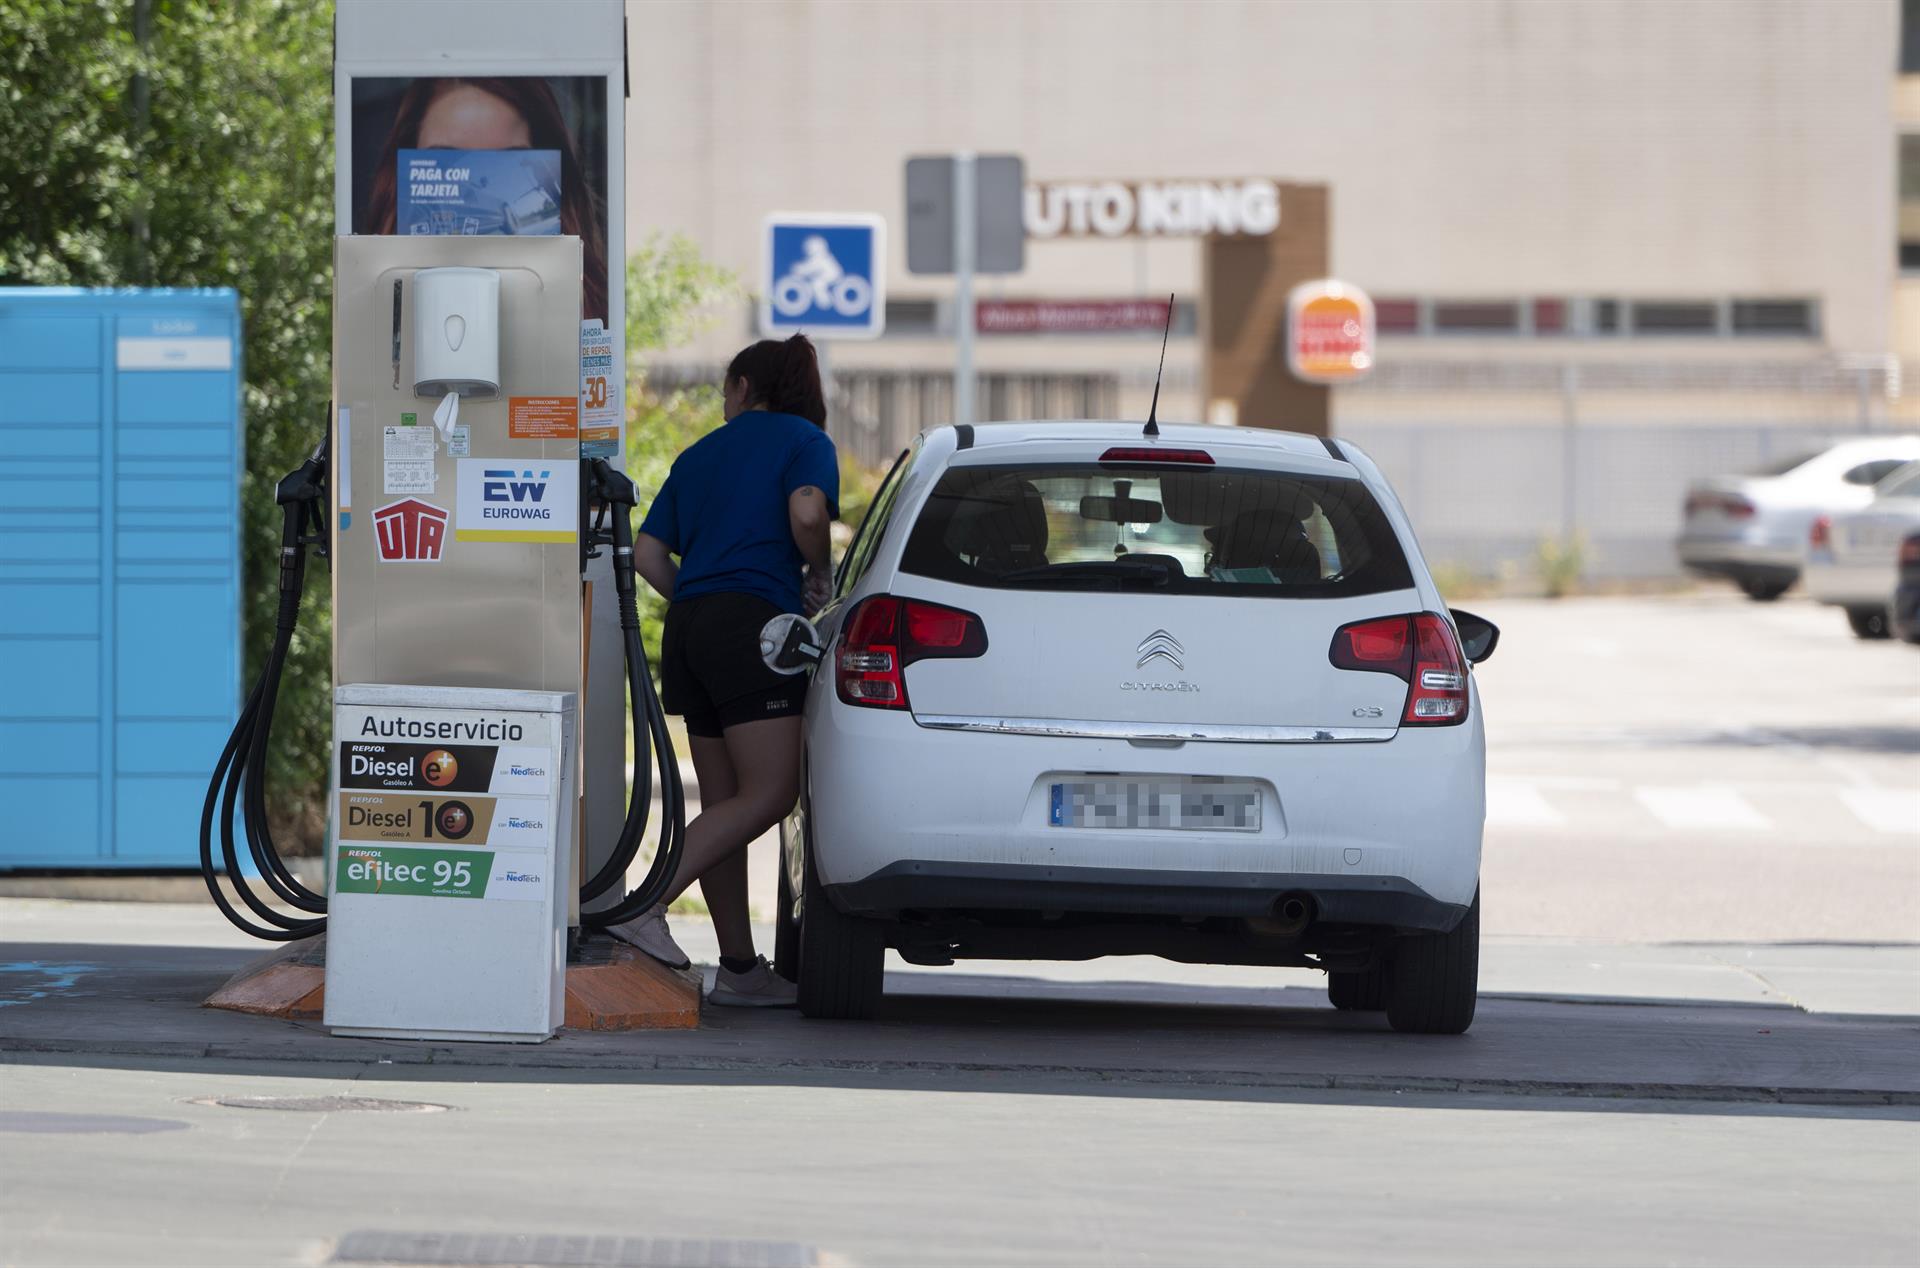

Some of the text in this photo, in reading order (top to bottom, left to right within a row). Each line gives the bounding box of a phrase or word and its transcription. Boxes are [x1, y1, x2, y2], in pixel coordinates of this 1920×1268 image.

[410, 168, 470, 182] PAGA CON
[410, 184, 460, 197] TARJETA
[1024, 179, 1280, 237] UTO KING
[583, 327, 602, 337] AHORA
[583, 345, 612, 356] DE REPSOL
[583, 366, 612, 377] DESCUENTO
[483, 507, 551, 520] EUROWAG
[374, 499, 447, 560] UTA
[1352, 706, 1384, 719] C3
[361, 716, 523, 741] Autoservicio
[352, 745, 386, 753] REPSOL
[350, 754, 414, 777] Diesel
[511, 767, 545, 776] NeoTech
[383, 778, 407, 786] Gasóleo
[350, 796, 384, 805] REPSOL
[349, 806, 412, 828] Diesel
[508, 820, 543, 830] NeoTech
[348, 849, 382, 858] REPSOL
[347, 859, 472, 888] efitec 95
[506, 873, 541, 883] NeoTech
